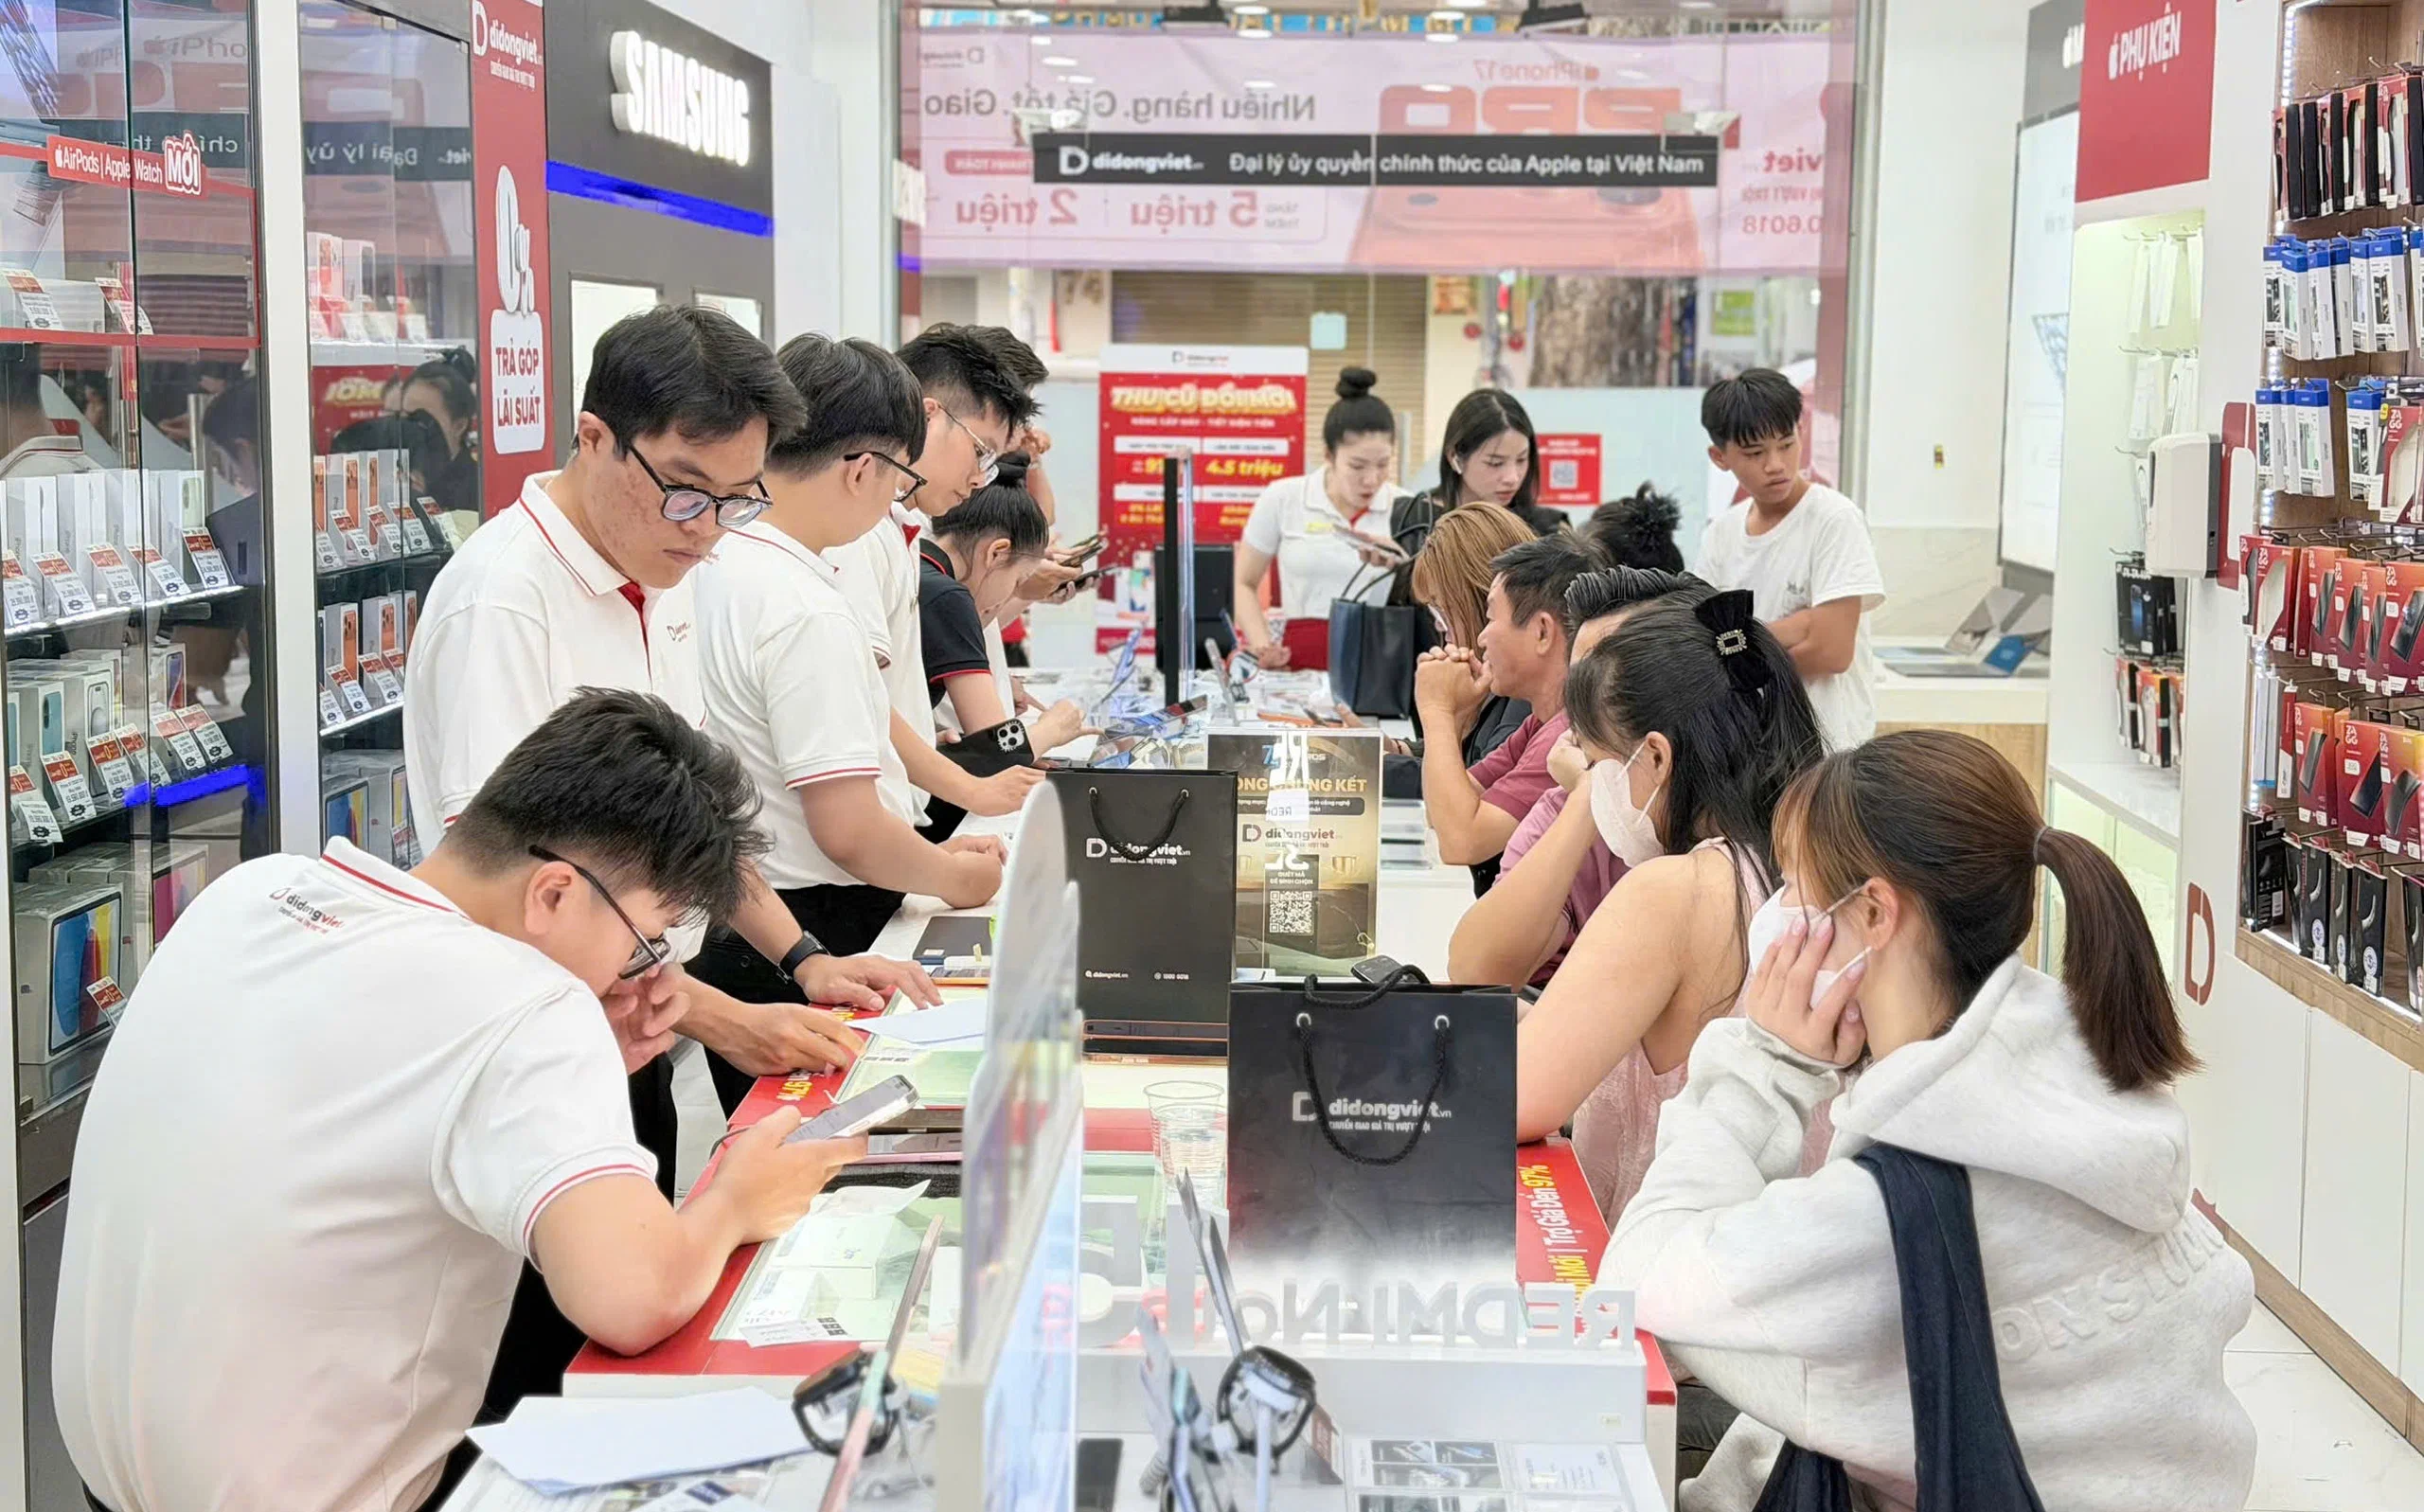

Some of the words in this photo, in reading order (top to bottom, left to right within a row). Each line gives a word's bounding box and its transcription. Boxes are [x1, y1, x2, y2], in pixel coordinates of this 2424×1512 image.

[2119, 24, 2148, 81] PHỤ
[2148, 2, 2182, 74] KIỆN
[610, 29, 750, 168] SAMSUNG
[62, 147, 100, 174] AirPods
[104, 153, 131, 182] Apple
[134, 158, 163, 185] Watch
[167, 134, 200, 190] MỚI
[1229, 152, 1262, 175] Đại
[1266, 152, 1284, 175] lý
[1288, 150, 1310, 175] ủy
[1380, 152, 1433, 174] chính
[1437, 152, 1482, 174] thức
[1487, 151, 1521, 174] của
[1524, 155, 1582, 178] Apple
[1587, 154, 1610, 177] tại
[1614, 152, 1653, 177] Việt
[1658, 155, 1703, 174] Nam
[496, 337, 516, 377] TRẢ
[518, 340, 540, 376] GÓP
[497, 389, 513, 427] LÃI
[515, 384, 541, 426] SUẤT
[1335, 774, 1367, 792] KẾT
[1328, 1098, 1452, 1120] didongvit.vn
[1518, 1165, 1556, 1188] 97%
[1520, 1187, 1564, 1209] Đến
[1531, 1209, 1570, 1227] Giá
